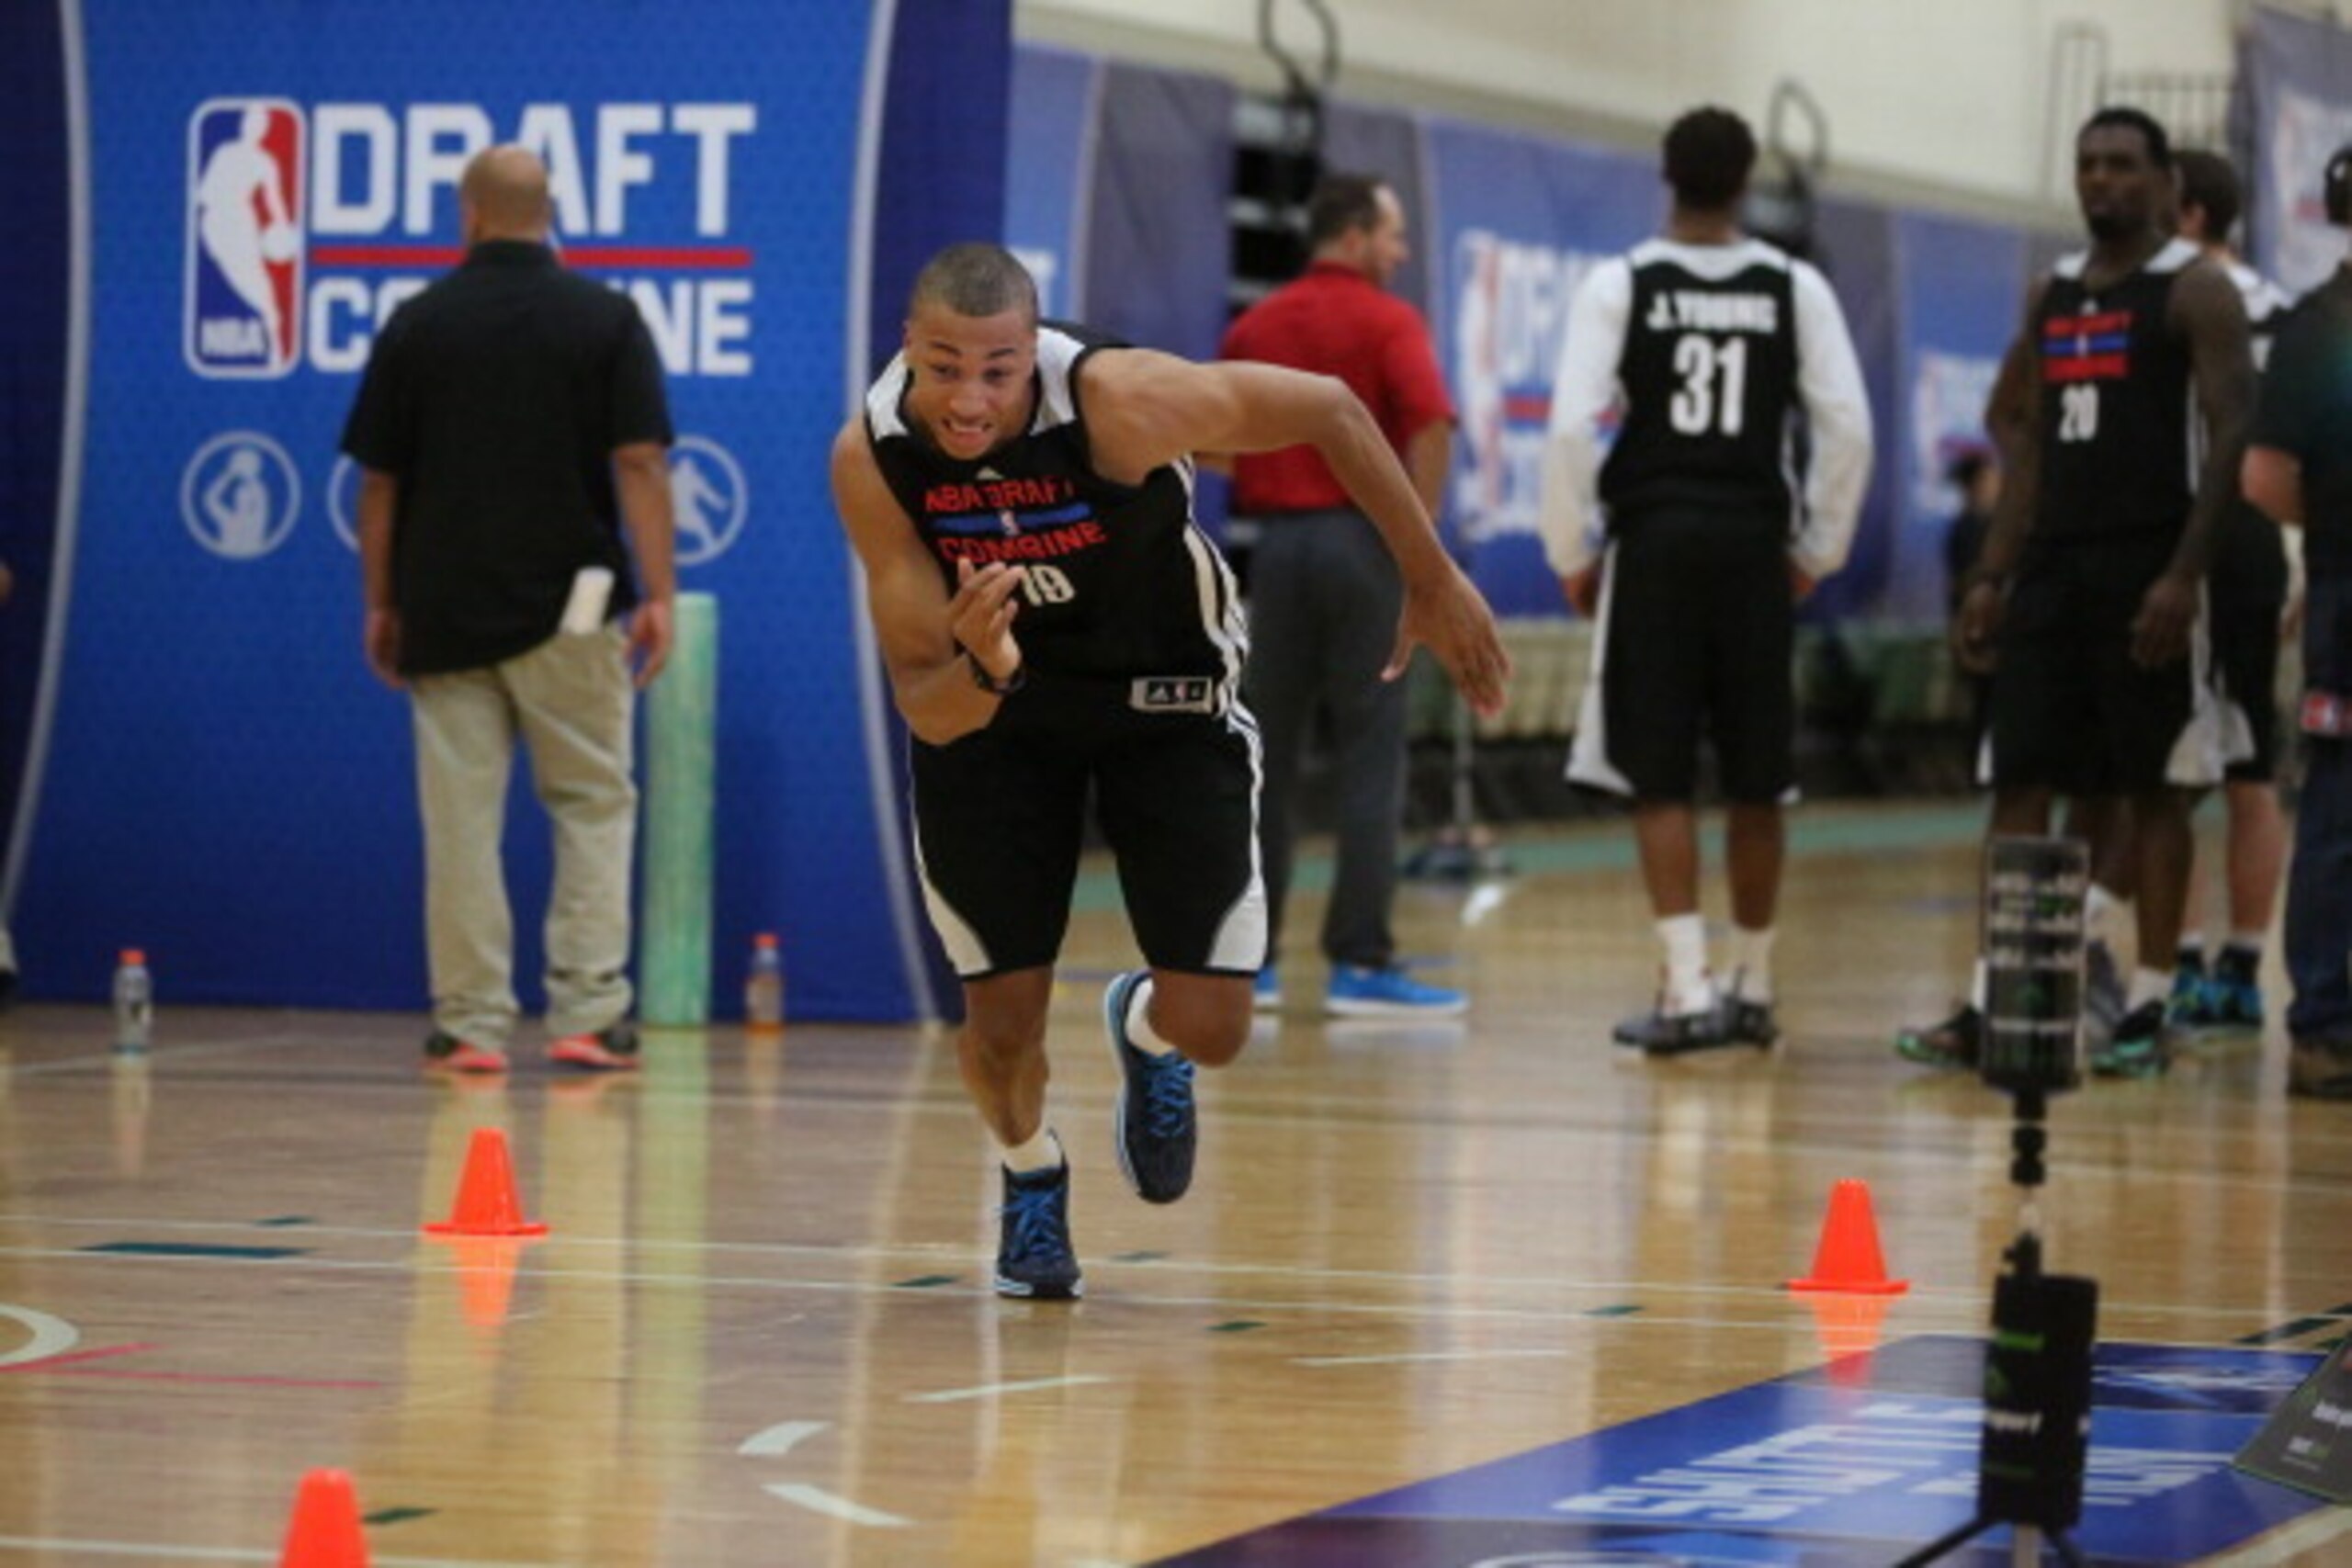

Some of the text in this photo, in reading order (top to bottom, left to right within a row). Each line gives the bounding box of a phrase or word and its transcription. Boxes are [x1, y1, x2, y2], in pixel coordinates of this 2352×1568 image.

[309, 103, 756, 236] DRAFT
[1669, 332, 1747, 437] 31
[984, 475, 1075, 508] DRAF
[937, 520, 1106, 565] COMBINE
[1021, 565, 1076, 606] 19
